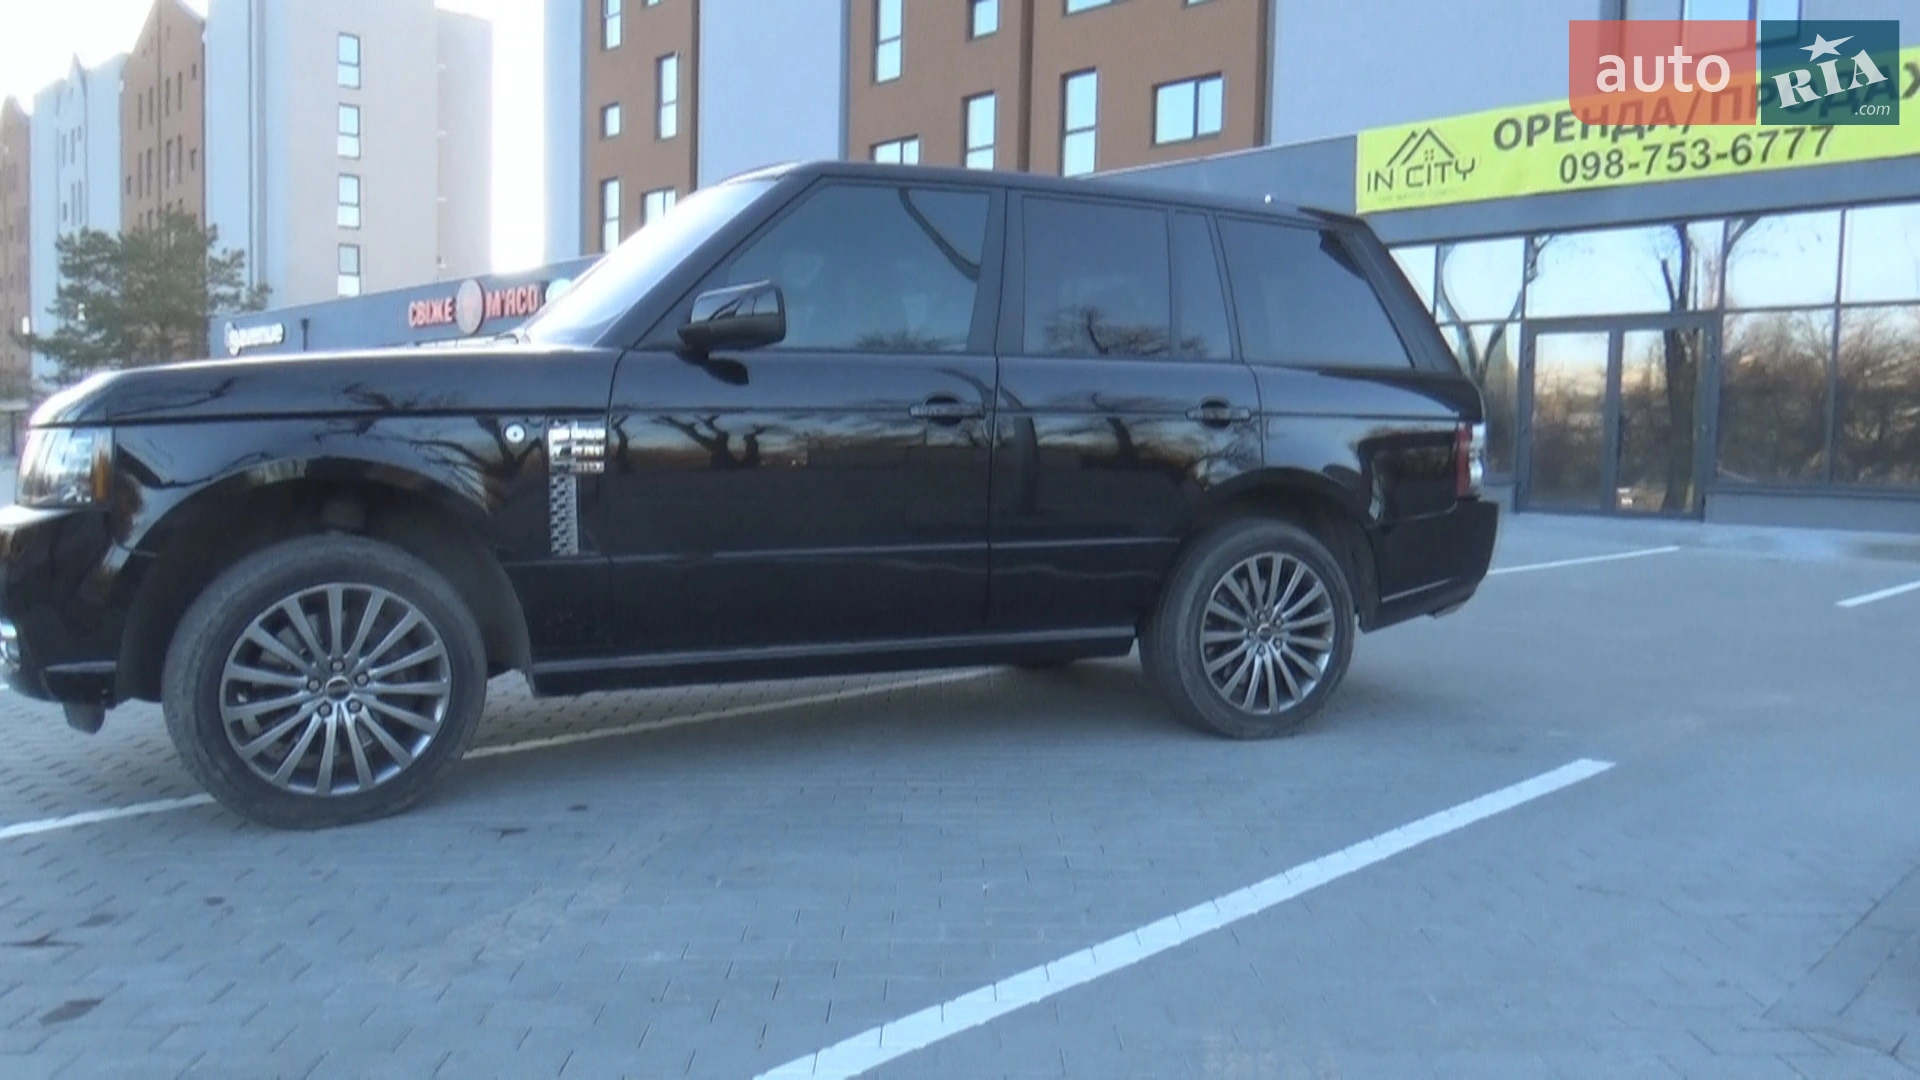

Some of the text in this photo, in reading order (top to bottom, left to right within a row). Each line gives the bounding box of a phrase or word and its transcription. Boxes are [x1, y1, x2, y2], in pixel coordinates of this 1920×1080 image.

[1559, 123, 1835, 184] 098-753-6777
[1366, 157, 1476, 193] IN CITY
[408, 297, 454, 328] СВІЖЕ
